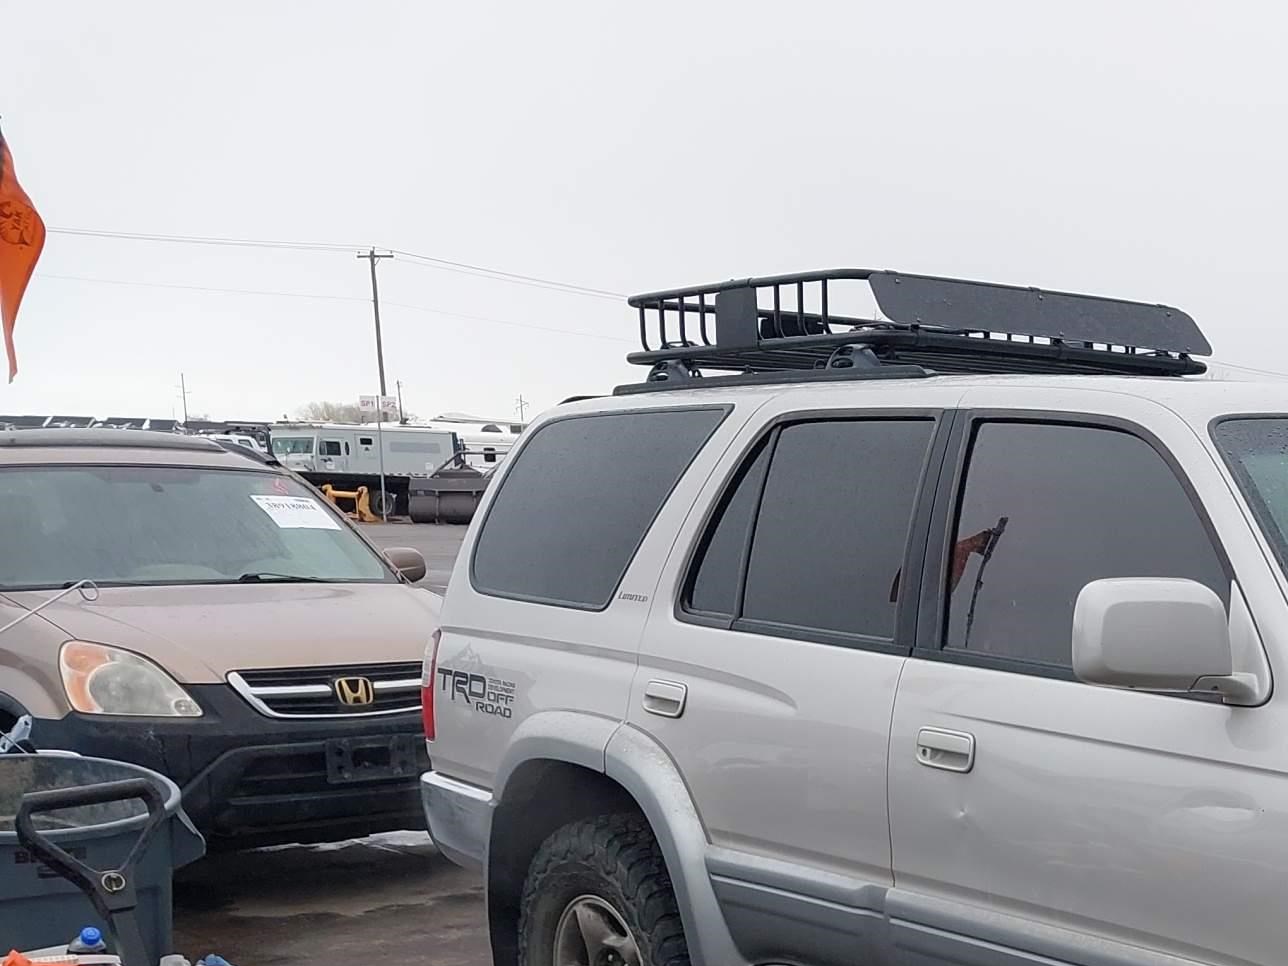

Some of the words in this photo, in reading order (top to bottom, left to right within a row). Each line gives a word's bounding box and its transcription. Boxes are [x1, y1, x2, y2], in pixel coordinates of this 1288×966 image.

[437, 667, 487, 704] TRD
[487, 691, 515, 705] OFF
[475, 701, 512, 719] ROAD
